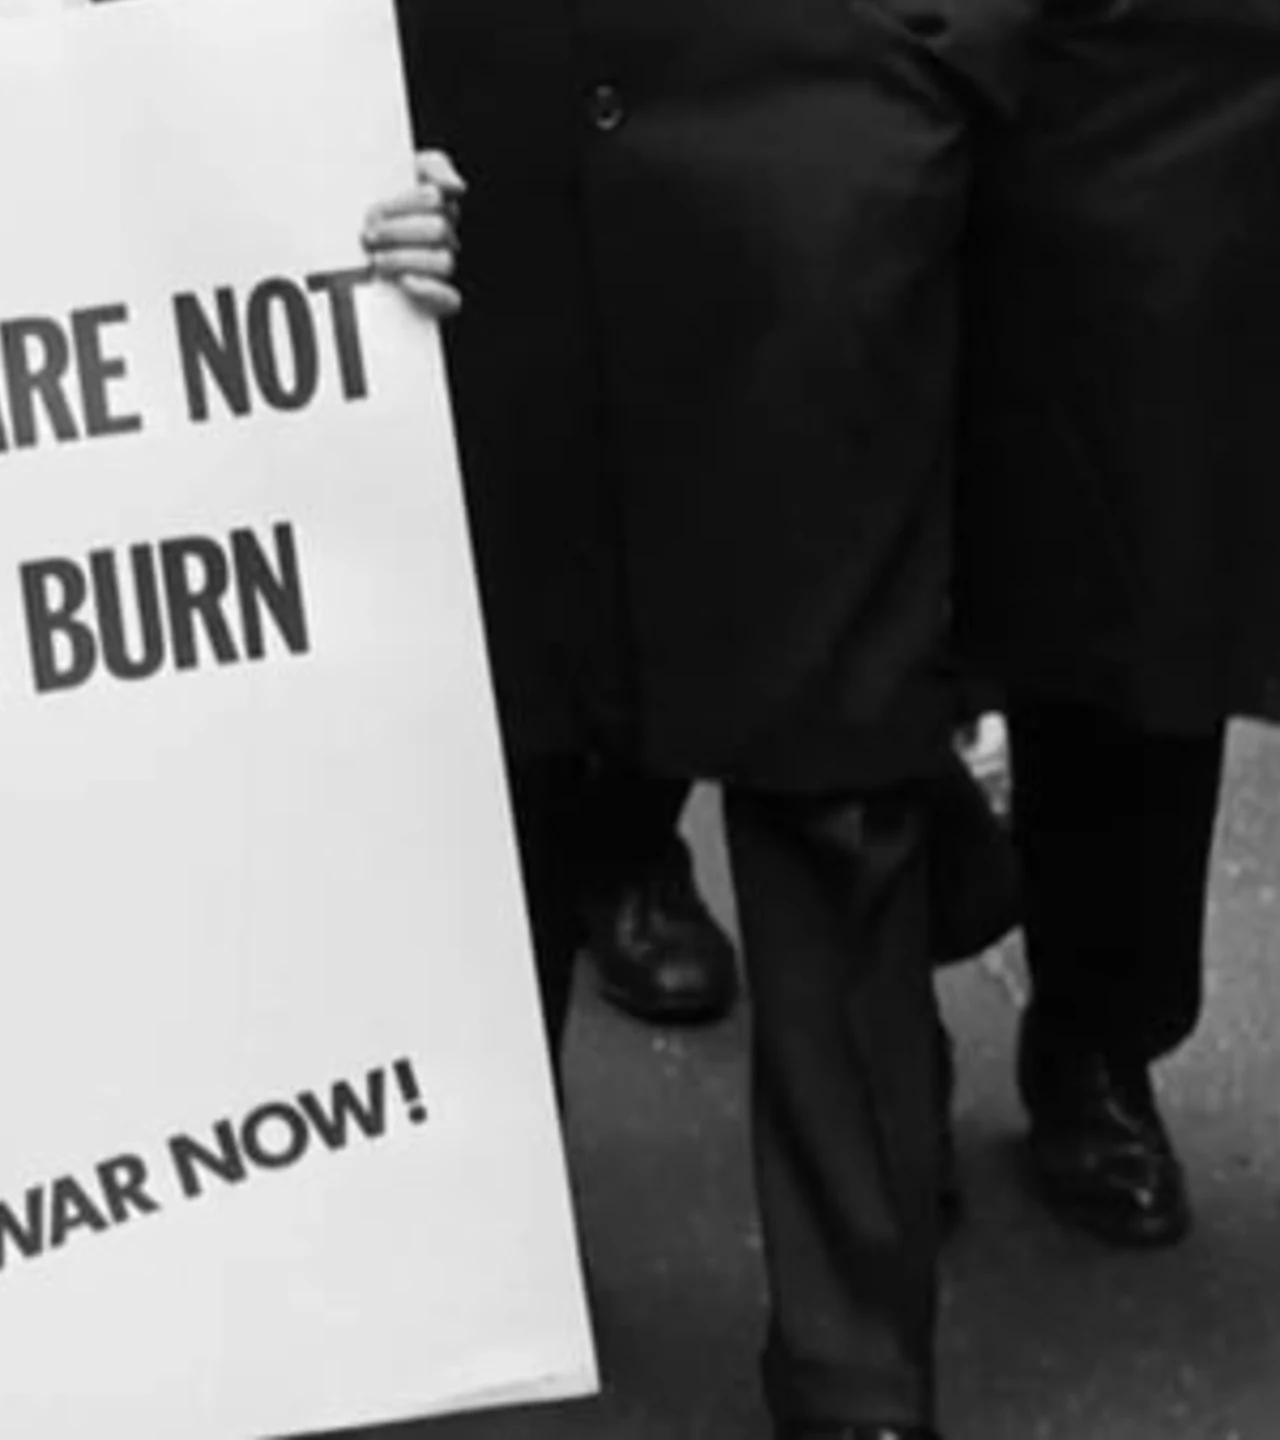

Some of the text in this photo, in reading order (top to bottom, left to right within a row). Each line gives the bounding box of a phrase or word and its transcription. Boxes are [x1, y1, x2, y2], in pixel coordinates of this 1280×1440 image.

[173, 266, 376, 421] NOT
[20, 522, 308, 692] BURN
[169, 1059, 426, 1197] NOW!
